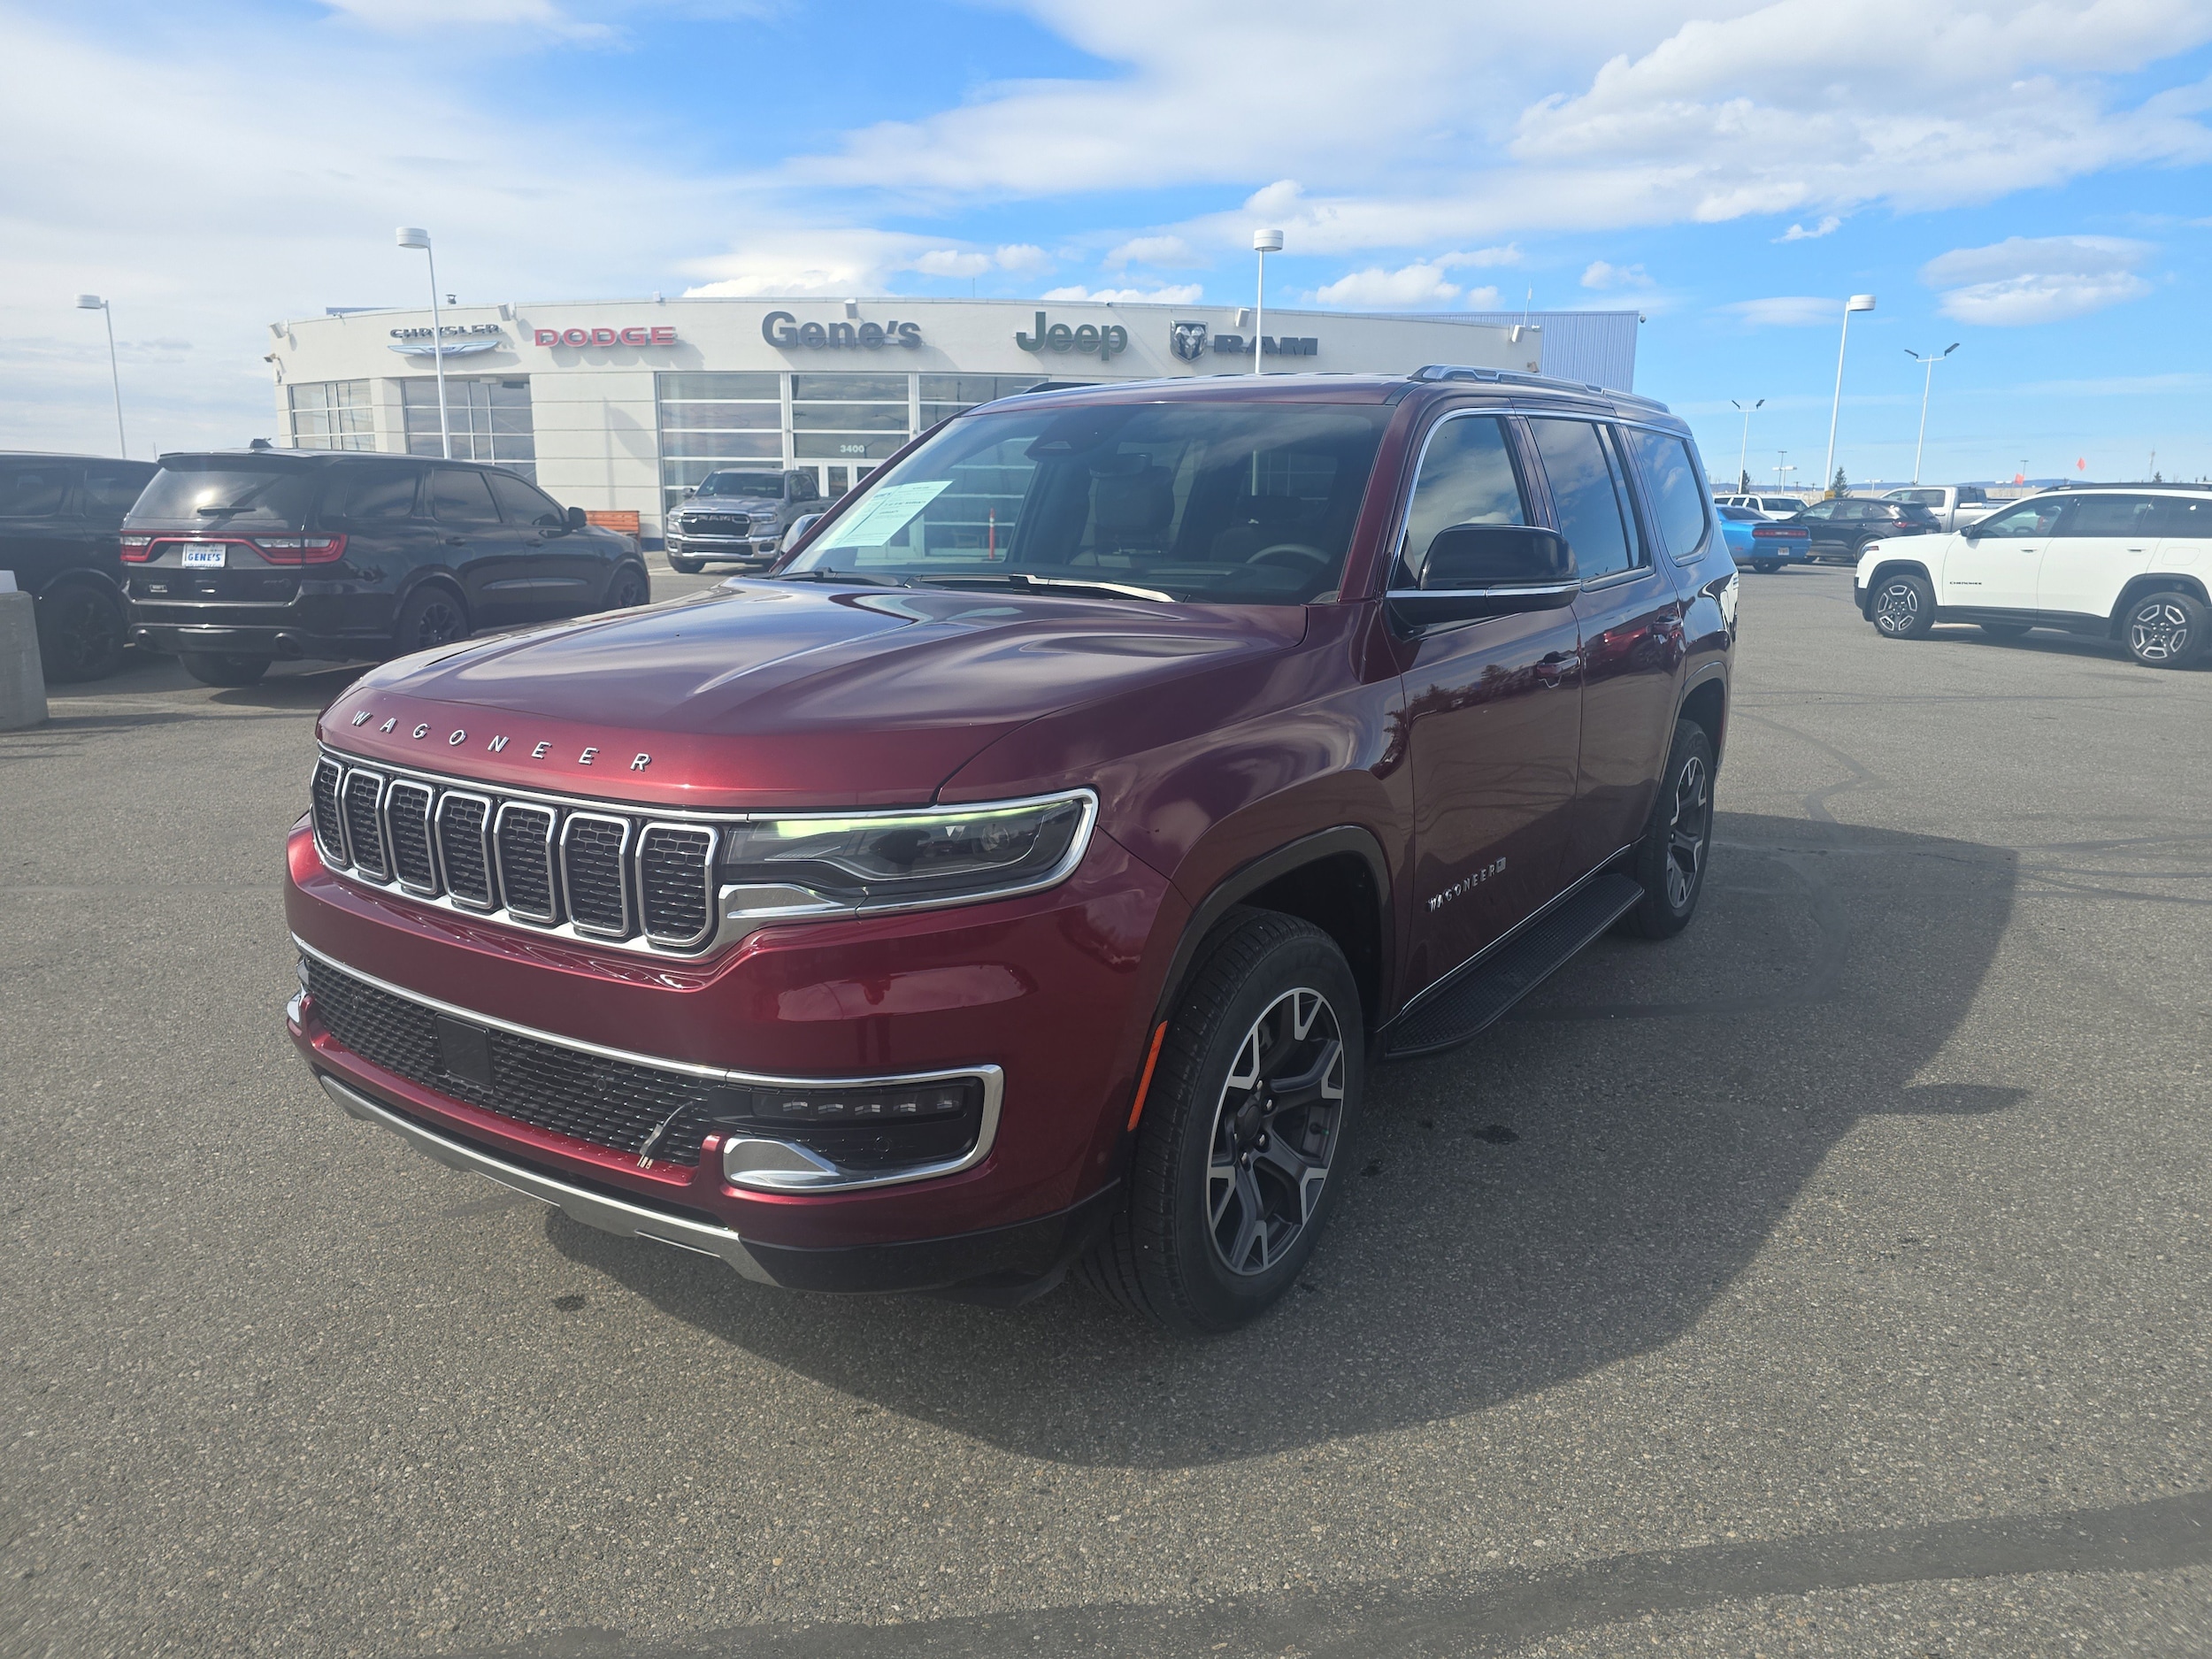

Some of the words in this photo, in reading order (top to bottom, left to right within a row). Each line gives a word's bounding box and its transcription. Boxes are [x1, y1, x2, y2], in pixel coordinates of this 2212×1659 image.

[534, 326, 678, 347] DODGE
[762, 311, 923, 349] Gene's
[1016, 311, 1128, 361] Jeep
[1214, 334, 1318, 356] RAM
[840, 444, 865, 453] 3400
[188, 552, 221, 562] GENE'S
[351, 710, 652, 772] WAGONEER
[1427, 863, 1495, 912] WAGONEER
